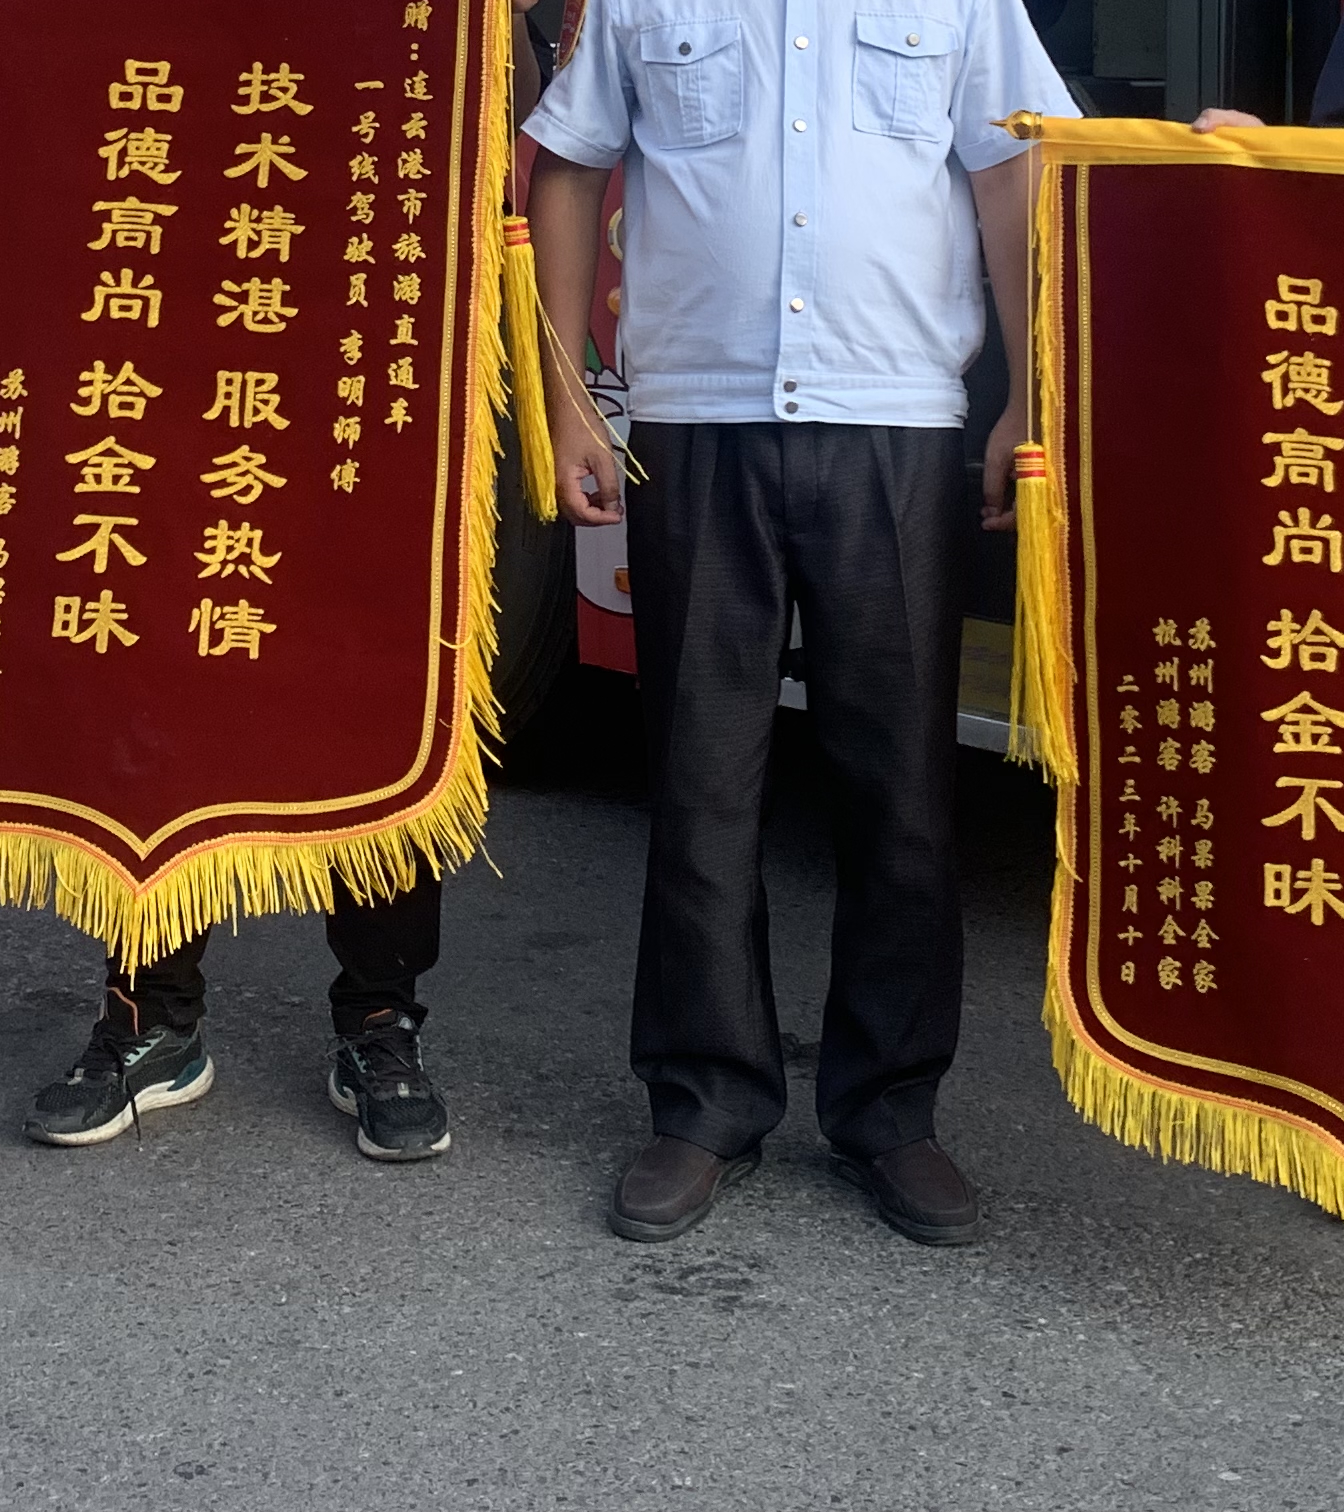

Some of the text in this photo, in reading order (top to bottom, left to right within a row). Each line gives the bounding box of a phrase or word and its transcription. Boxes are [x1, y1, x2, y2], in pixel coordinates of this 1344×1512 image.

[81, 58, 185, 329] 品德高尚
[188, 61, 315, 660] 技术精湛 服务热情
[1116, 674, 1143, 985] 二零二三年十月十日
